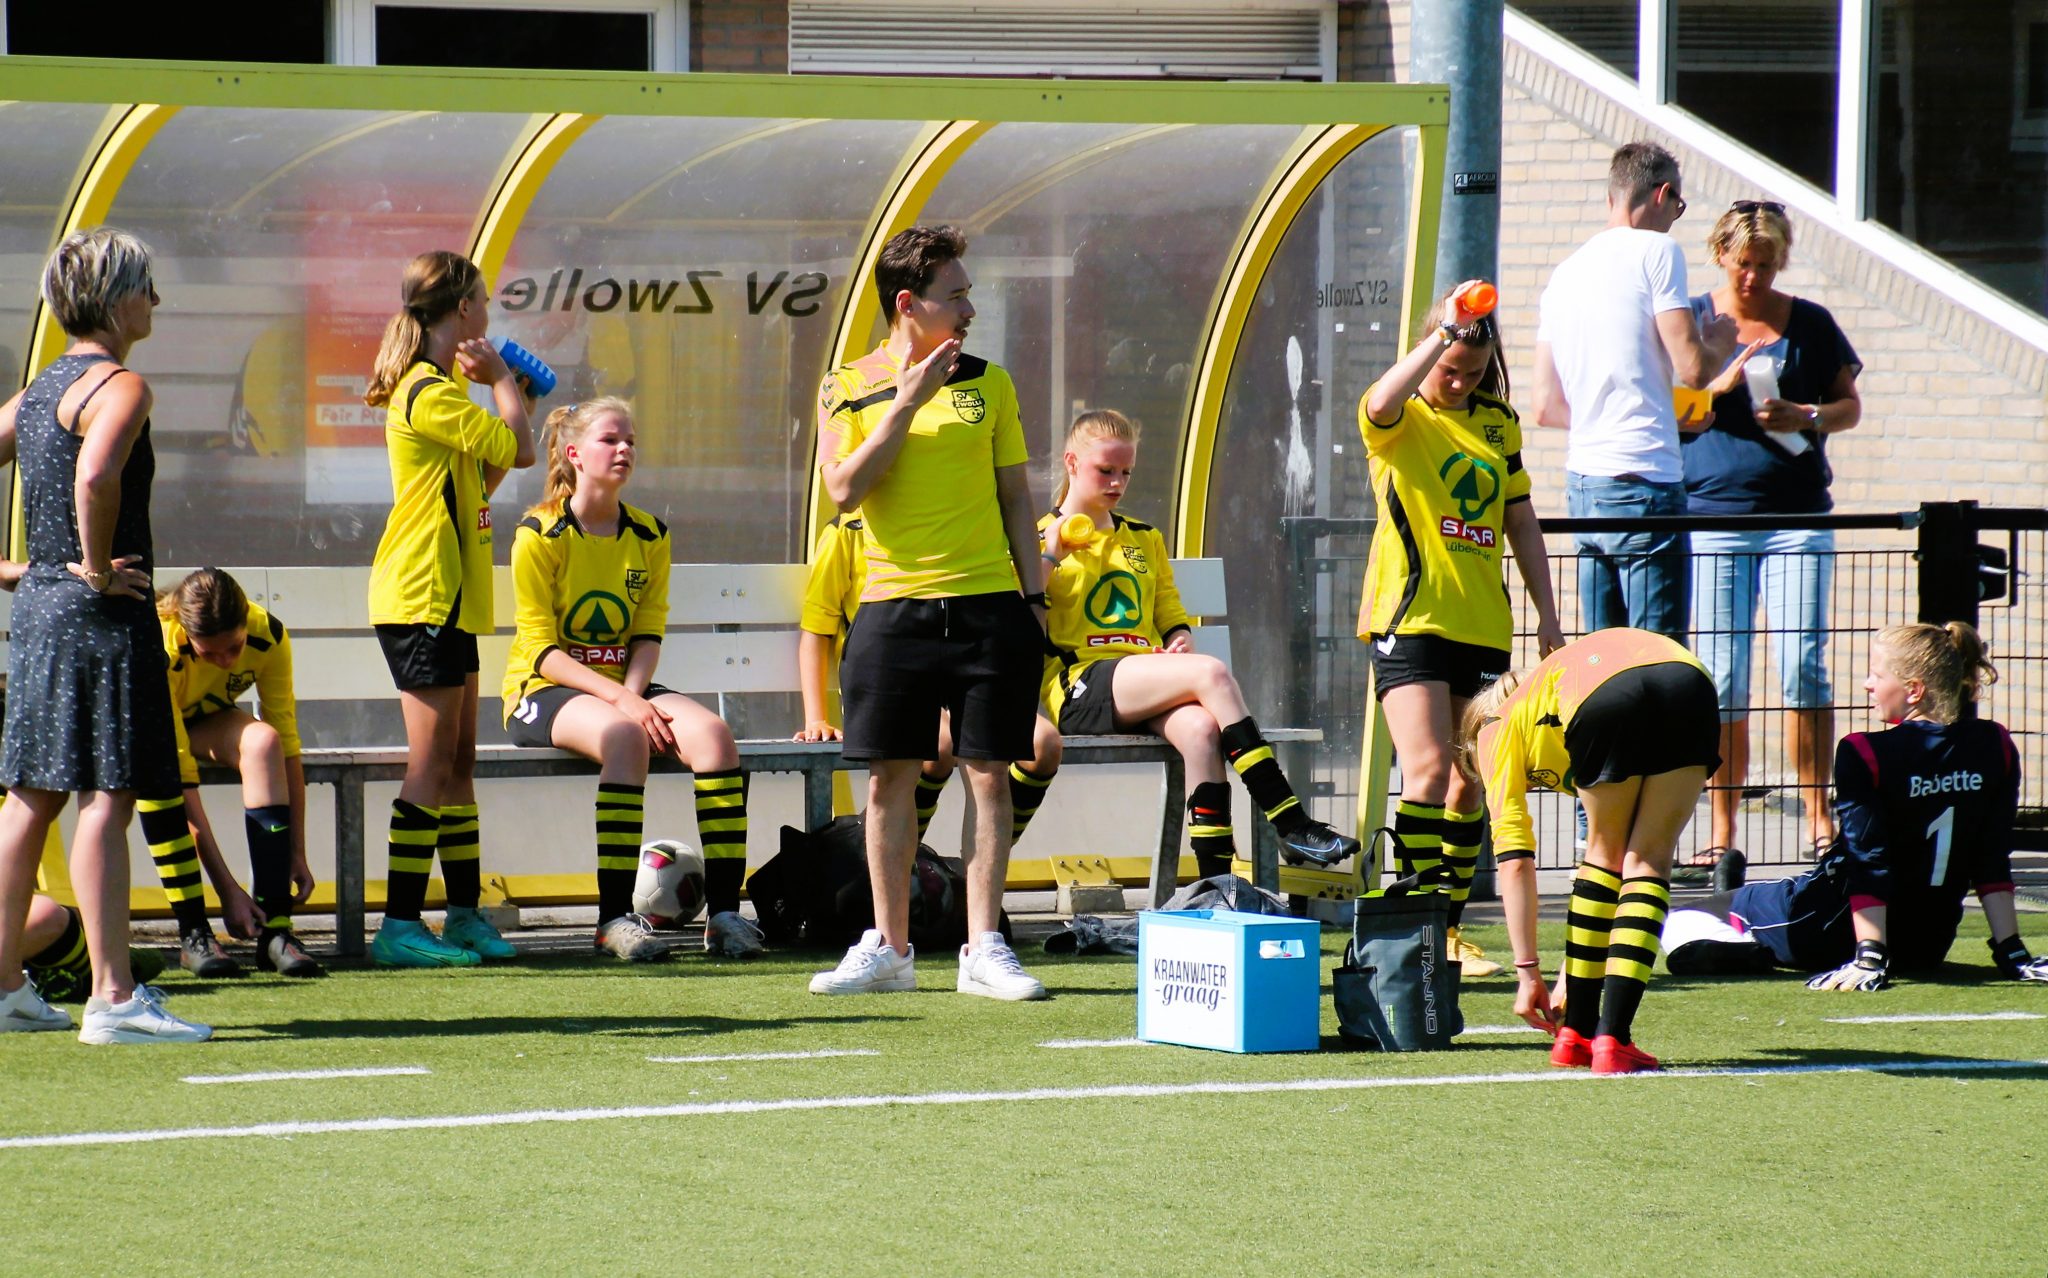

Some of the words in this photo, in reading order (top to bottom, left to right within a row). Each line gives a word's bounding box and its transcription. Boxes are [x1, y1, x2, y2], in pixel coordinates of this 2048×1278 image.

[956, 392, 968, 401] SV
[320, 409, 353, 423] Fair
[360, 409, 386, 423] Pla
[570, 648, 625, 663] SPAR
[1909, 770, 1983, 798] Babette
[1926, 806, 1955, 886] 1
[1154, 958, 1227, 987] KRAANWATER
[1422, 925, 1438, 1035] STANNO
